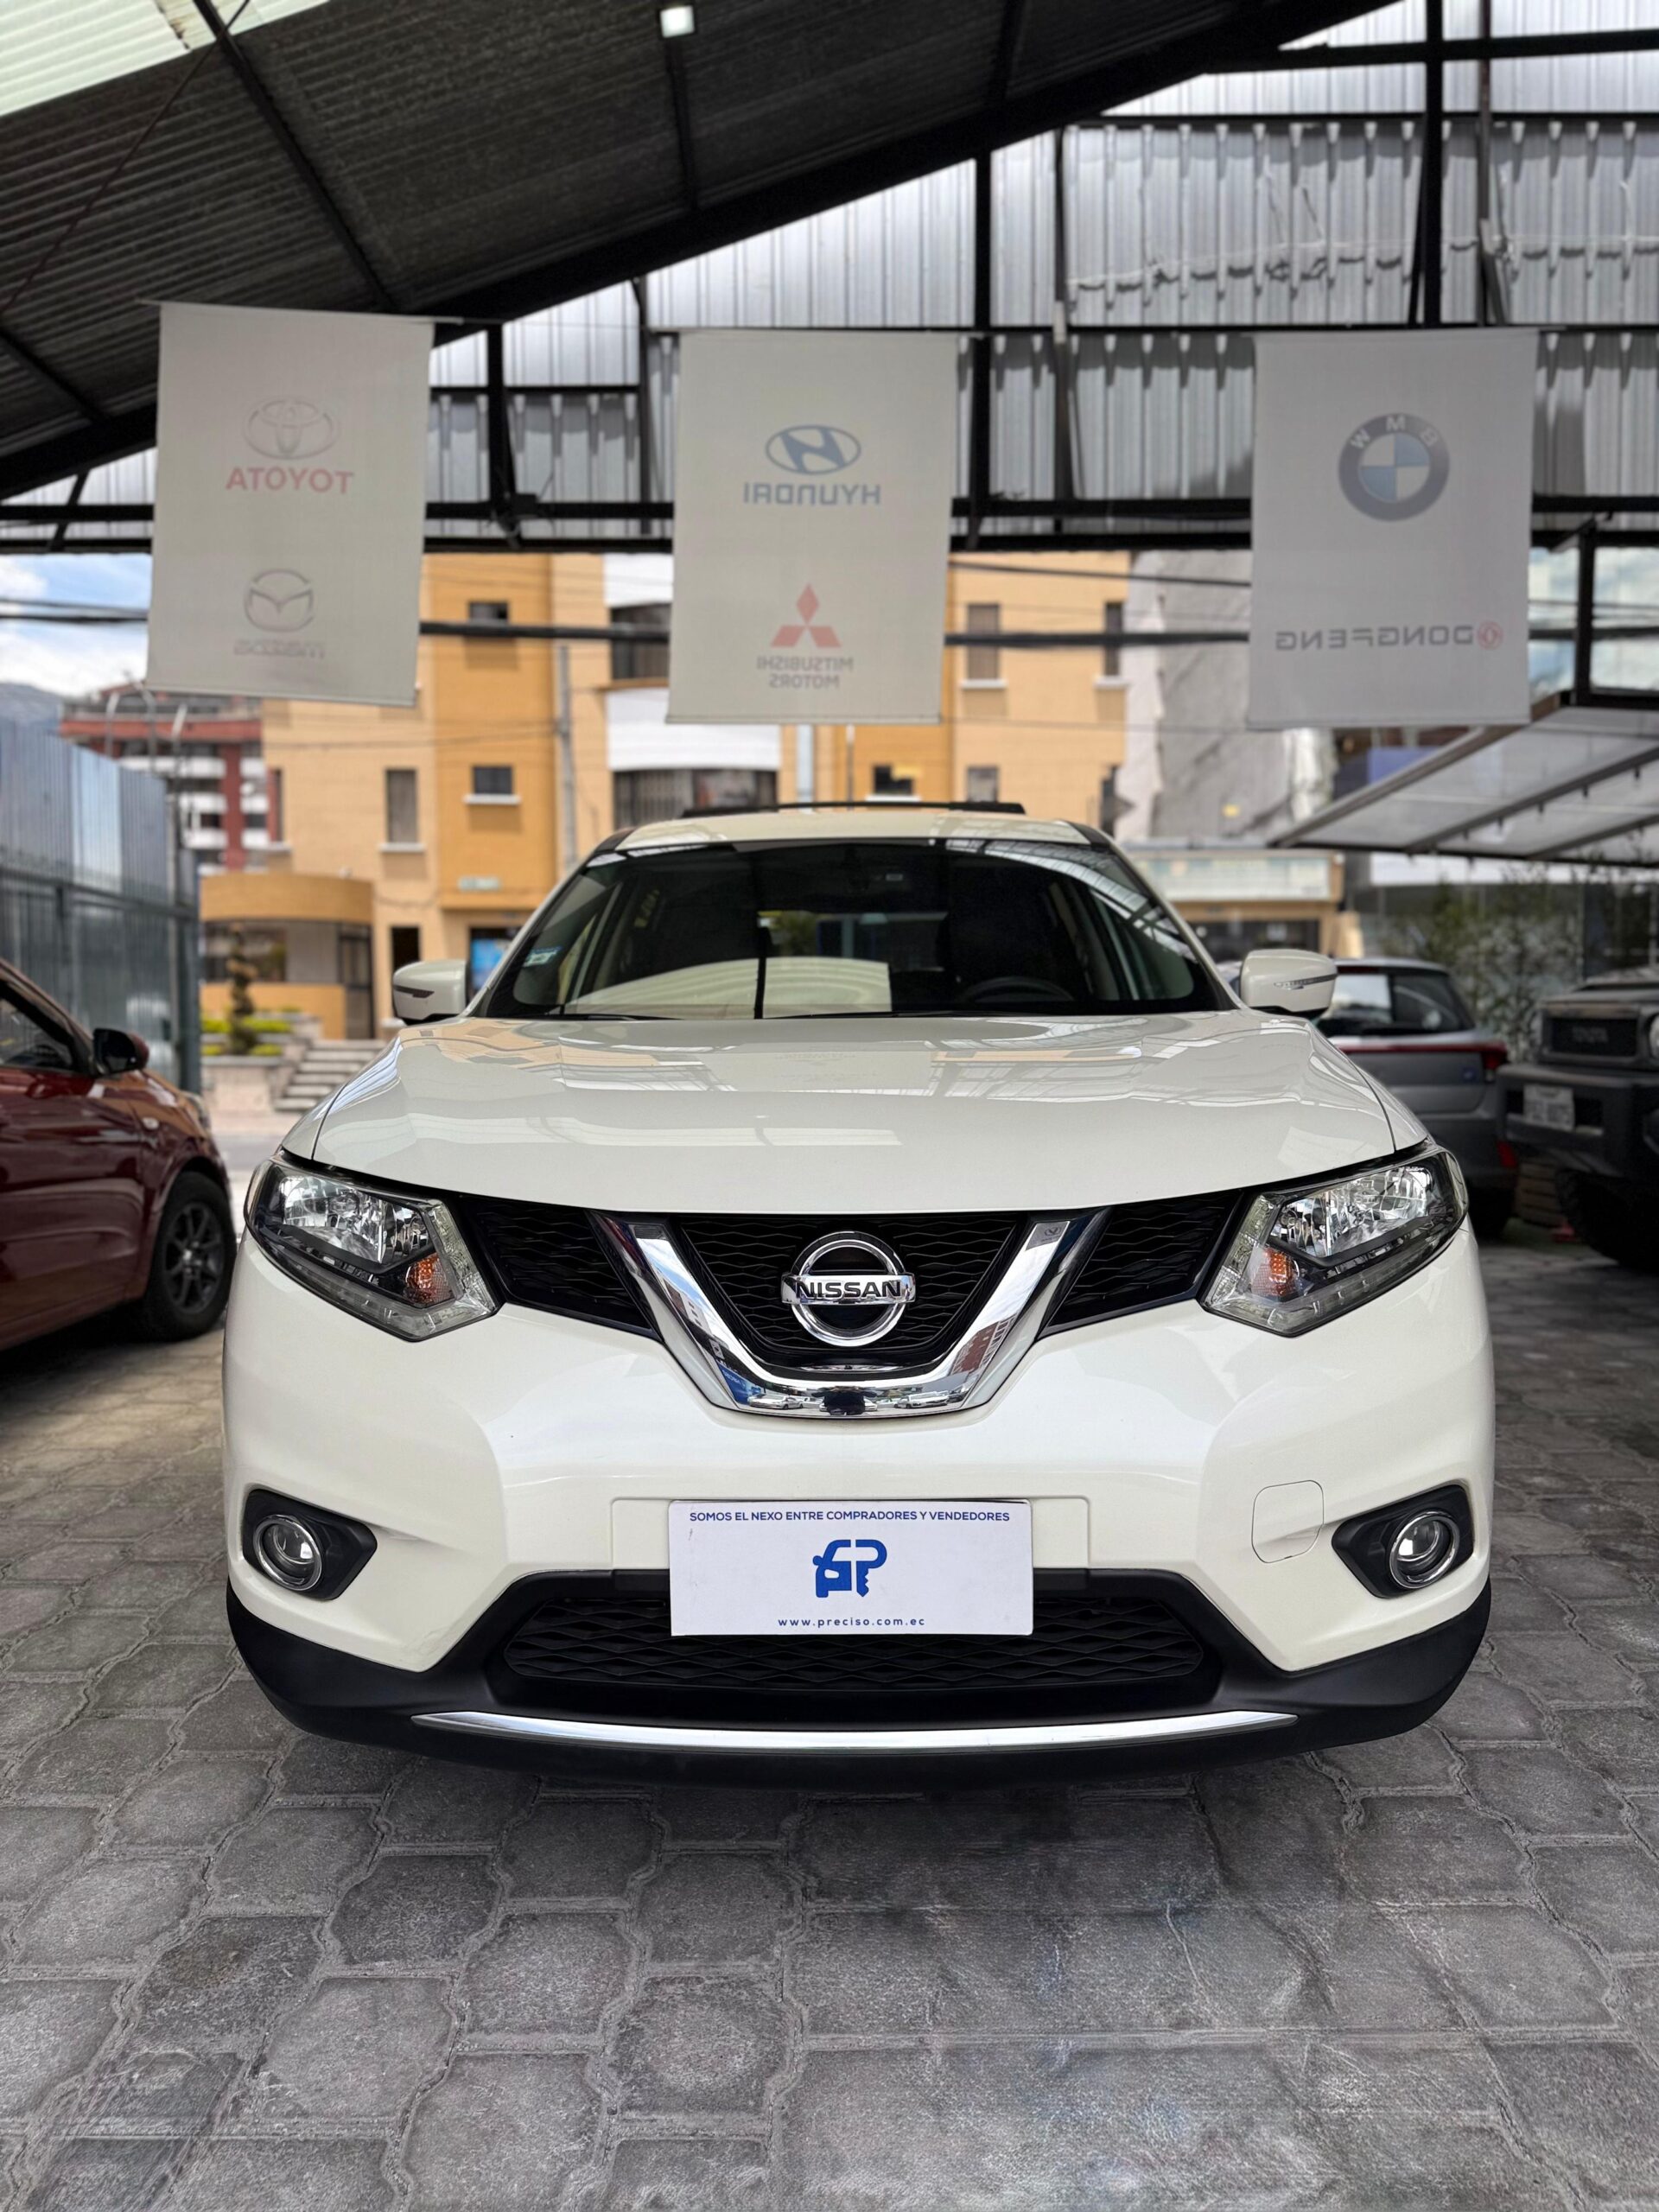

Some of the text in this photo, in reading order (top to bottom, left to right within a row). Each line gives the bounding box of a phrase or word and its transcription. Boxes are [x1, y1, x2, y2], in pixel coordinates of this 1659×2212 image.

[796, 1281, 901, 1300] NISSAN
[690, 1510, 1010, 1522] SOMOS EL NEXO ENTRE COMPRADORES Y VENDEDORES
[778, 1617, 926, 1629] www.preciso.com.ec
